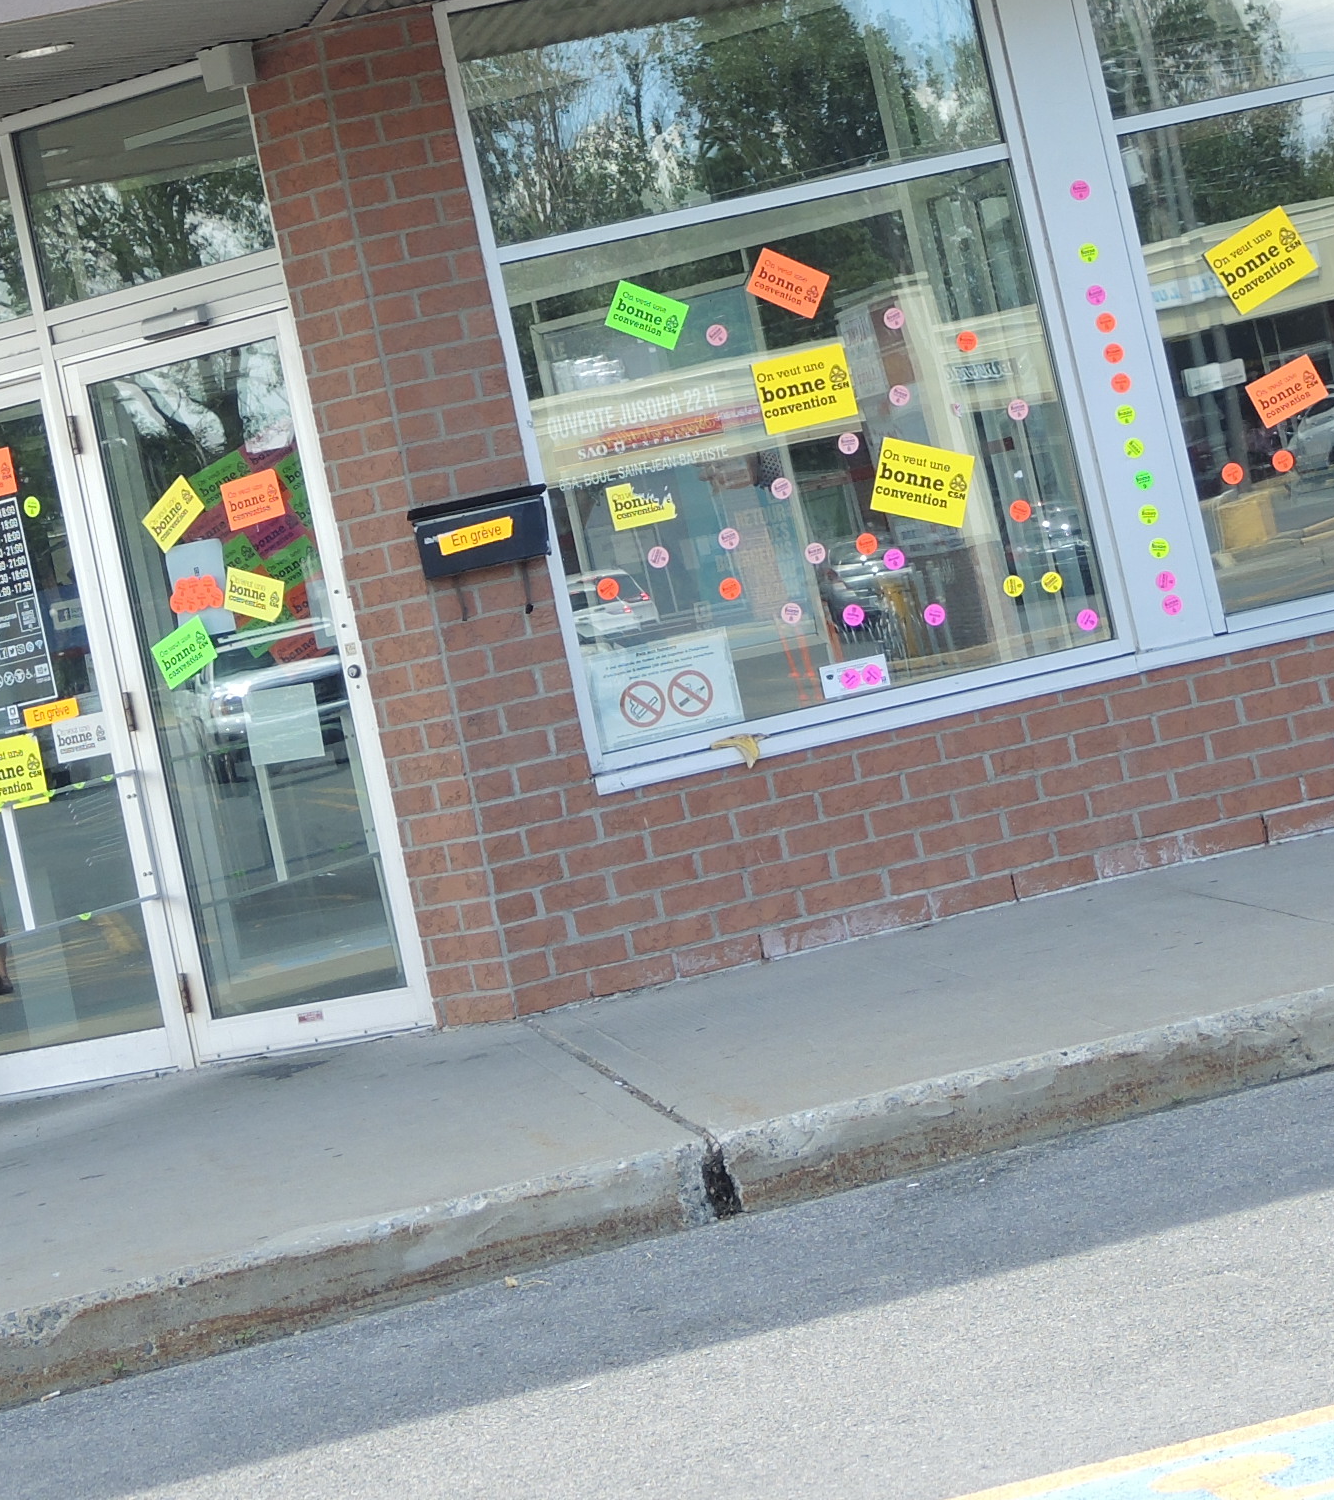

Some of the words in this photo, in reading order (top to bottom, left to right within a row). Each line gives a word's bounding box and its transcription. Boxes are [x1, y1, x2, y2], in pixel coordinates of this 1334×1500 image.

[1213, 256, 1230, 269] On
[1230, 239, 1253, 259] veut
[1254, 229, 1272, 243] une
[1285, 239, 1302, 253] CSN
[1220, 245, 1279, 286] bonne
[1232, 256, 1295, 300] convention
[754, 280, 802, 305] convention
[758, 267, 803, 294] bonne
[616, 298, 663, 326] bonne
[613, 313, 662, 337] convention
[756, 372, 774, 383] On
[776, 367, 802, 379] veut
[804, 361, 825, 373] une
[759, 378, 826, 404] bonne
[832, 382, 849, 391] CSN
[1258, 382, 1302, 410] bonne
[620, 388, 679, 430] JUSQU'À
[681, 389, 702, 412] 22
[704, 385, 715, 408] H
[764, 394, 837, 419] convention
[1266, 391, 1311, 419] convention
[577, 443, 608, 461] SAQ
[618, 445, 727, 478] SAINT-JEAN-BAPTISTE
[883, 448, 899, 462] On
[903, 453, 927, 468] veut
[930, 461, 951, 473] une
[879, 462, 944, 492] bonne
[229, 494, 266, 512] bonne
[875, 484, 948, 509] convention
[947, 490, 966, 500] CSN
[152, 502, 182, 536] bonne
[451, 533, 467, 547] En
[470, 525, 502, 545] grève
[229, 580, 265, 601] bonne
[33, 709, 45, 722] En
[47, 704, 70, 721] grève
[57, 732, 92, 747] bonne
